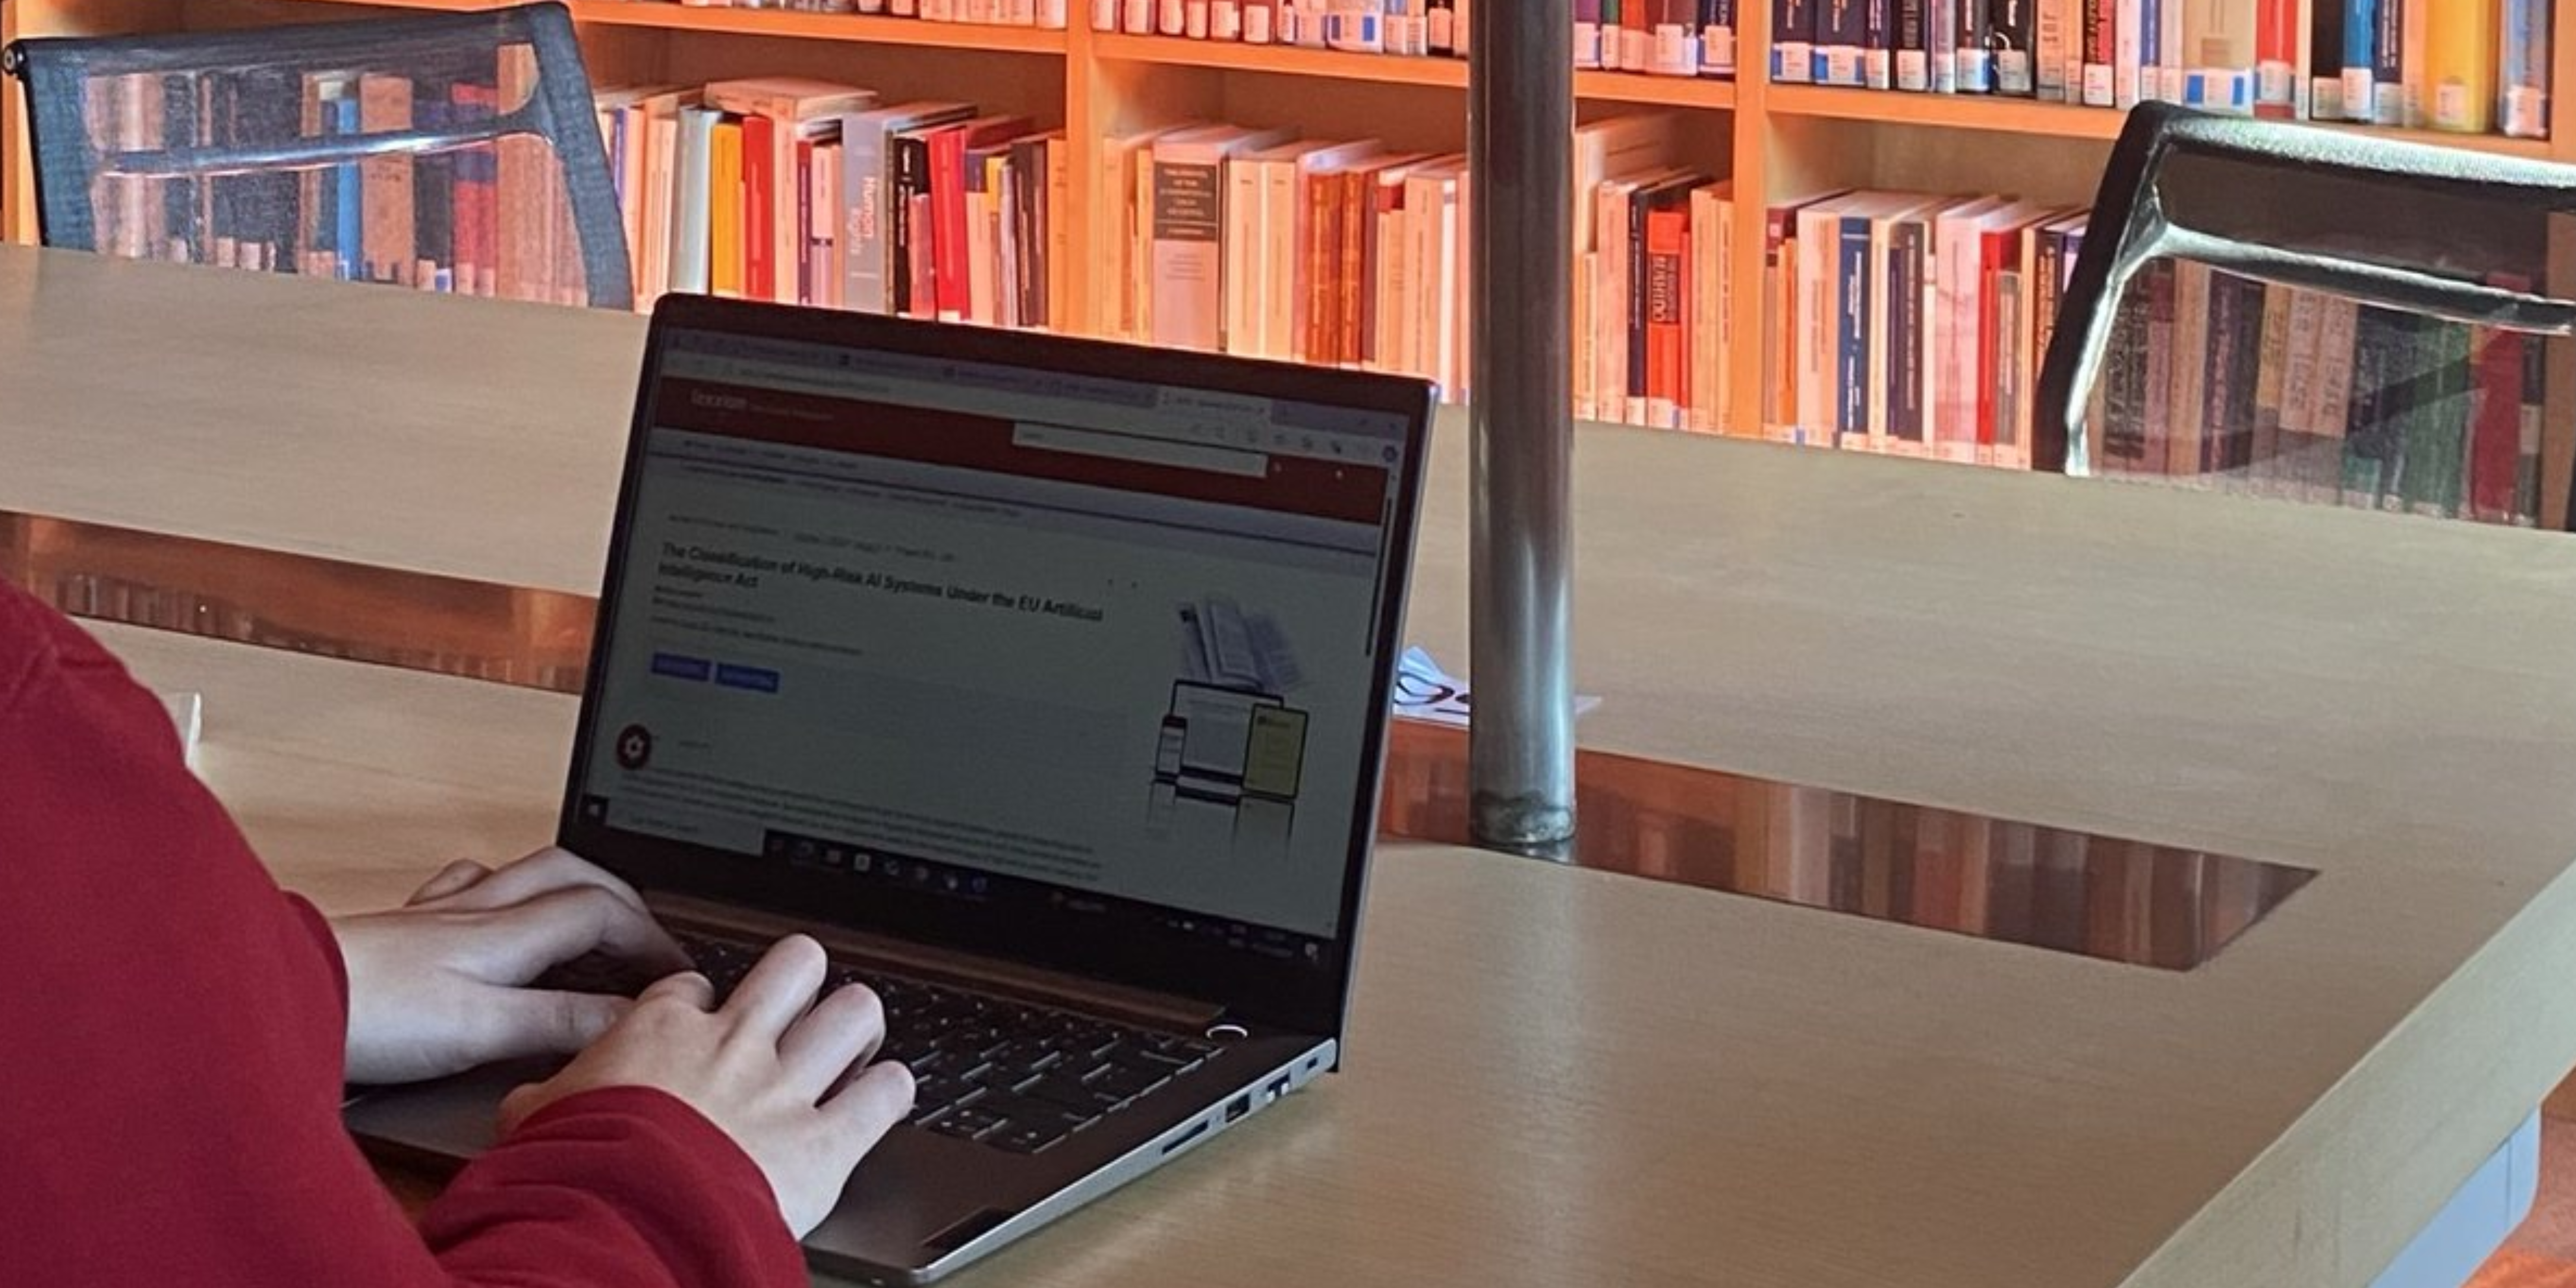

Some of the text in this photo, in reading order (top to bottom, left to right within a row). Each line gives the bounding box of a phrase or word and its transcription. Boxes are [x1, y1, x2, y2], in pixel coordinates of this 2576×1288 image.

[862, 176, 877, 239] Human
[658, 562, 758, 588] Intelligence Act
[663, 542, 685, 558] The
[689, 546, 778, 572] Classification
[782, 561, 796, 574] of
[797, 562, 862, 585] High-Risk
[866, 572, 882, 587] AI
[883, 575, 942, 597] Systems
[946, 584, 991, 603] Under
[992, 592, 1014, 608] the
[1018, 594, 1041, 612] EU
[1043, 598, 1104, 622] Artificial
